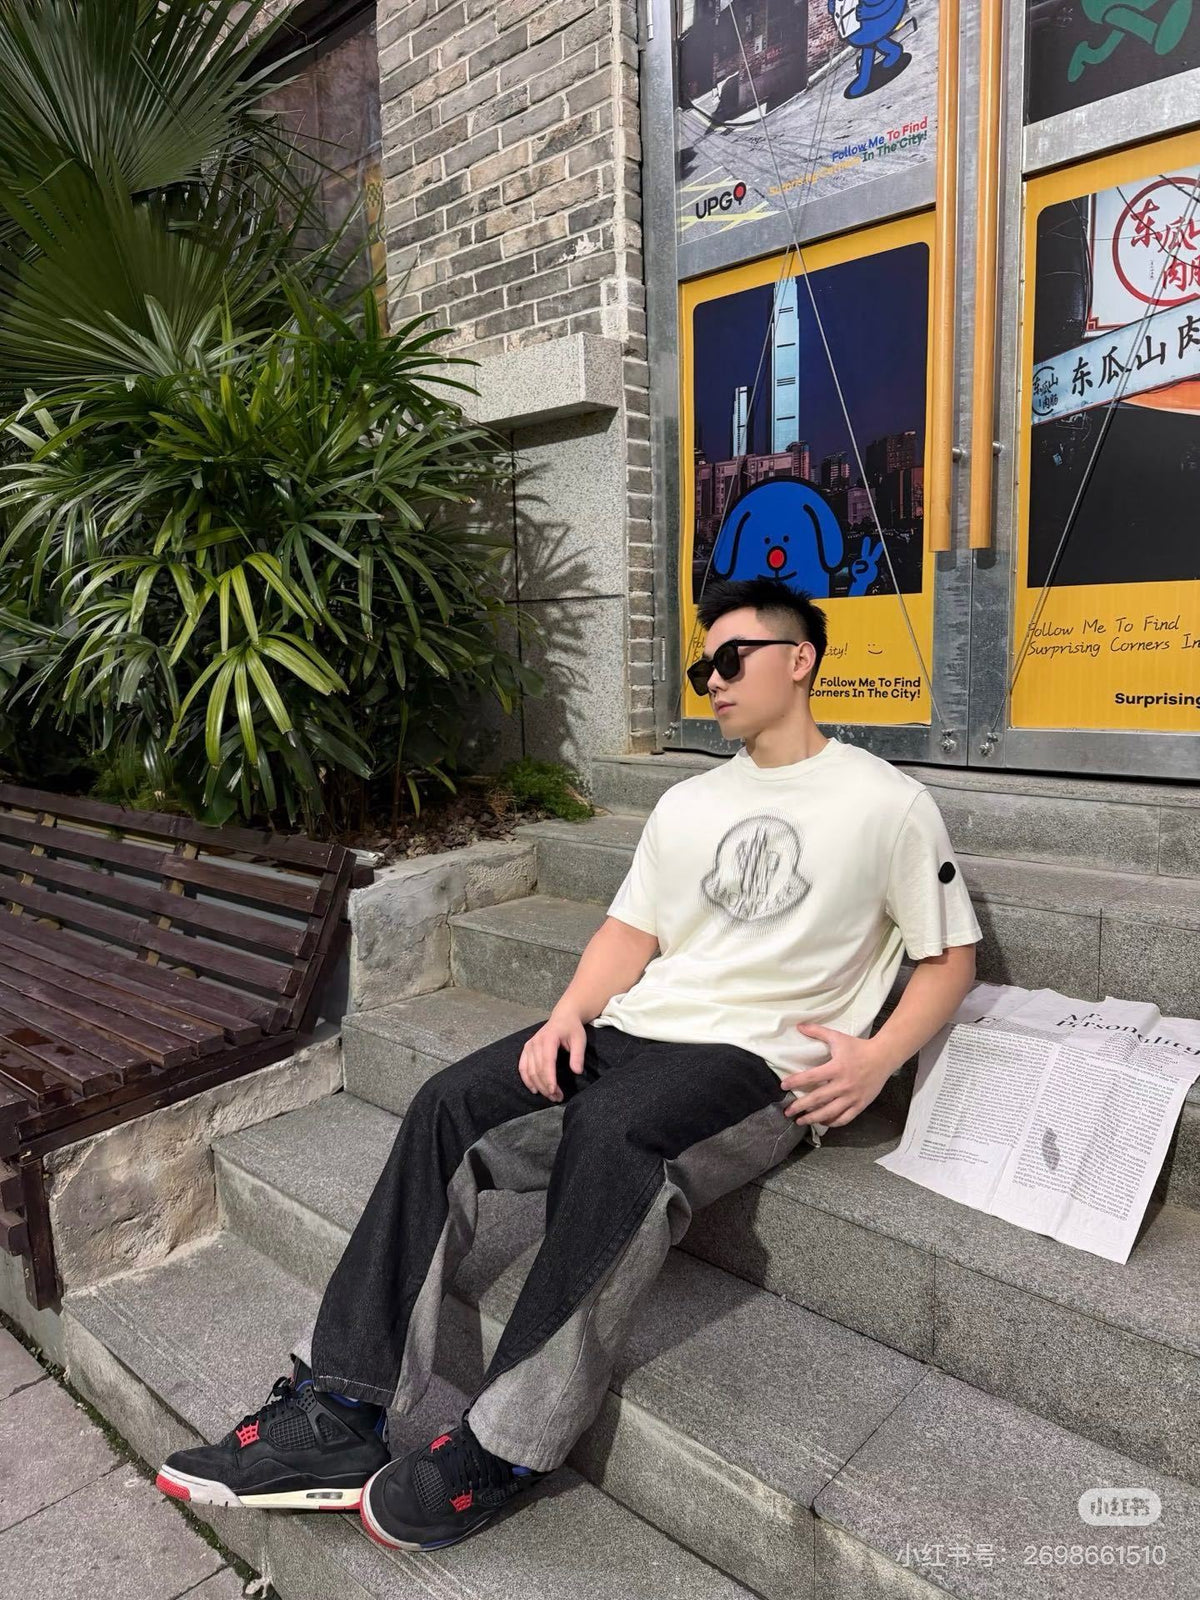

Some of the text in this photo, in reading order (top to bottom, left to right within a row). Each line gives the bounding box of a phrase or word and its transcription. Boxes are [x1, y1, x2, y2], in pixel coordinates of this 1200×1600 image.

[832, 115, 928, 162] Follow Me To Find
[862, 150, 875, 162] In
[877, 143, 898, 157] The
[899, 130, 928, 148] City!
[1027, 614, 1181, 638] Follow Me To Find
[1027, 640, 1101, 659] Surprising
[1110, 636, 1170, 652] Corners
[820, 676, 921, 688] Follow Me To Find
[809, 687, 921, 701] Corners In The City!
